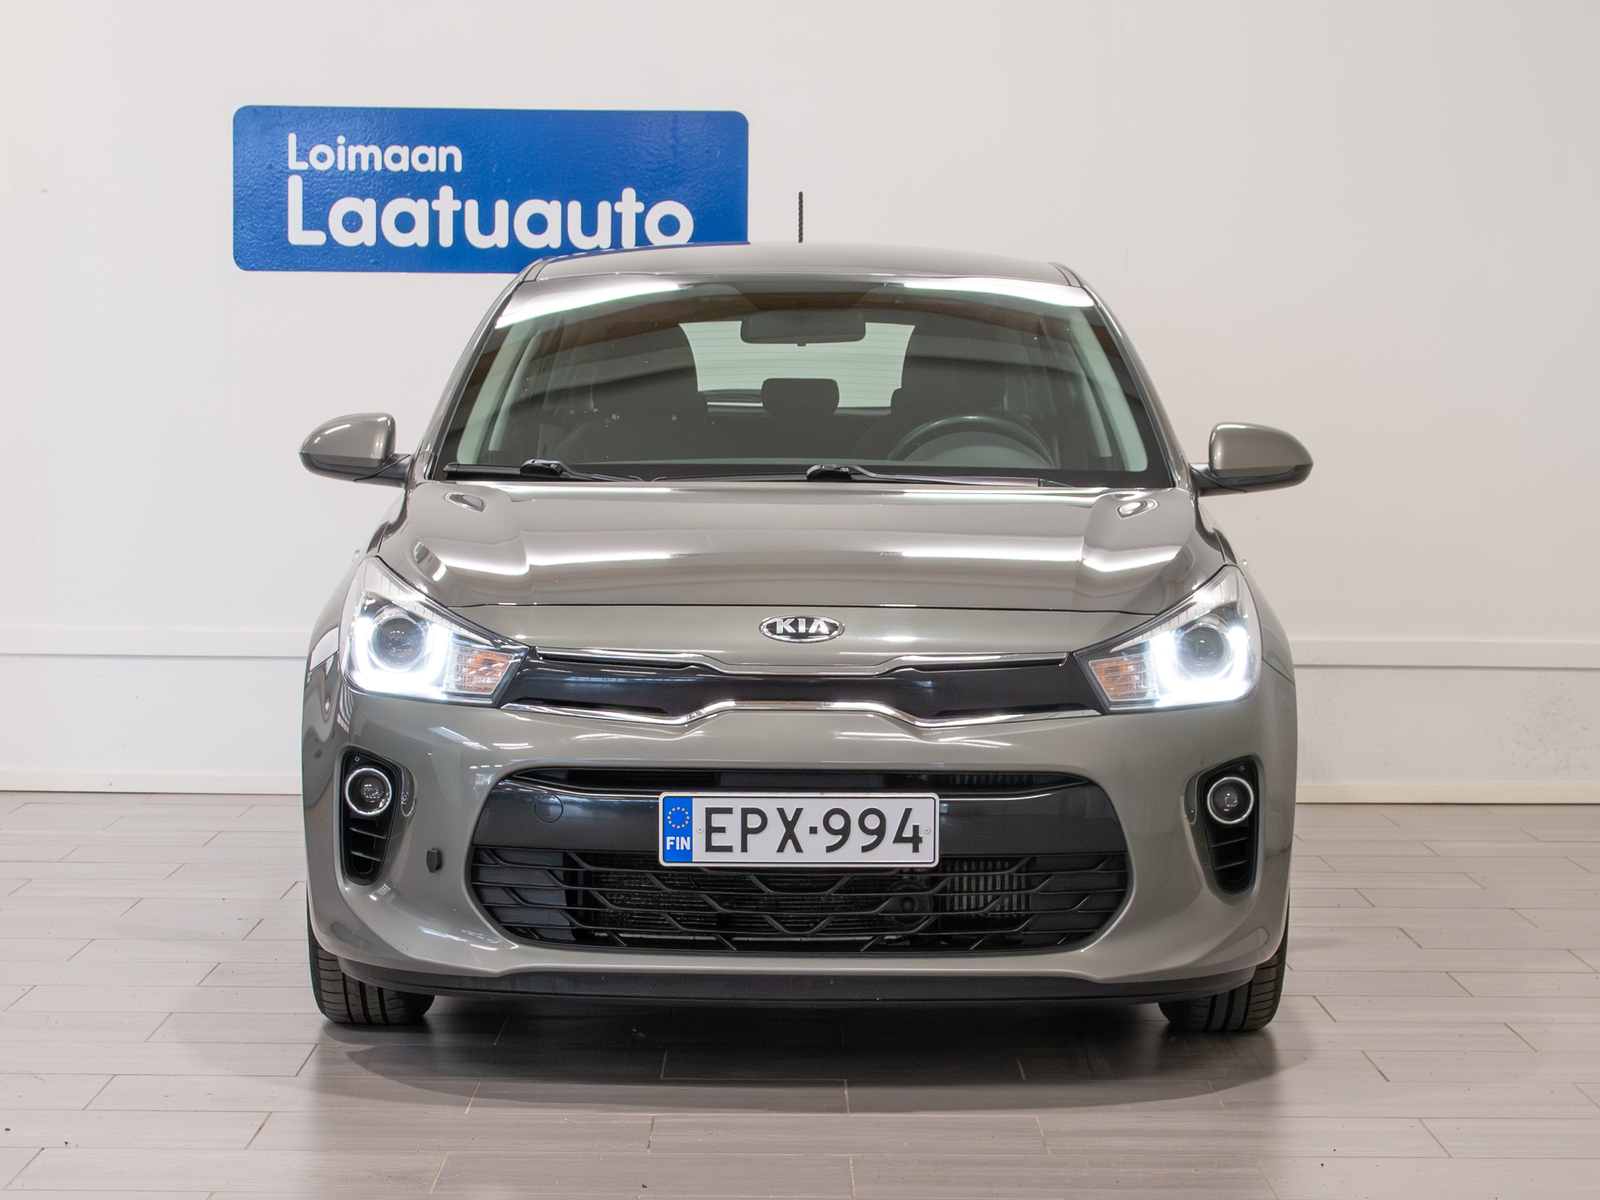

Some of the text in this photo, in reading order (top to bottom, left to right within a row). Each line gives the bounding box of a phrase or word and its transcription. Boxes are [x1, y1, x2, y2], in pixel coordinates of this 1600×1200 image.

[287, 132, 463, 173] Loimaan
[287, 174, 694, 250] Laatuauto
[776, 618, 830, 634] KIA
[666, 836, 691, 851] FIN
[704, 806, 924, 854] EPX-994
